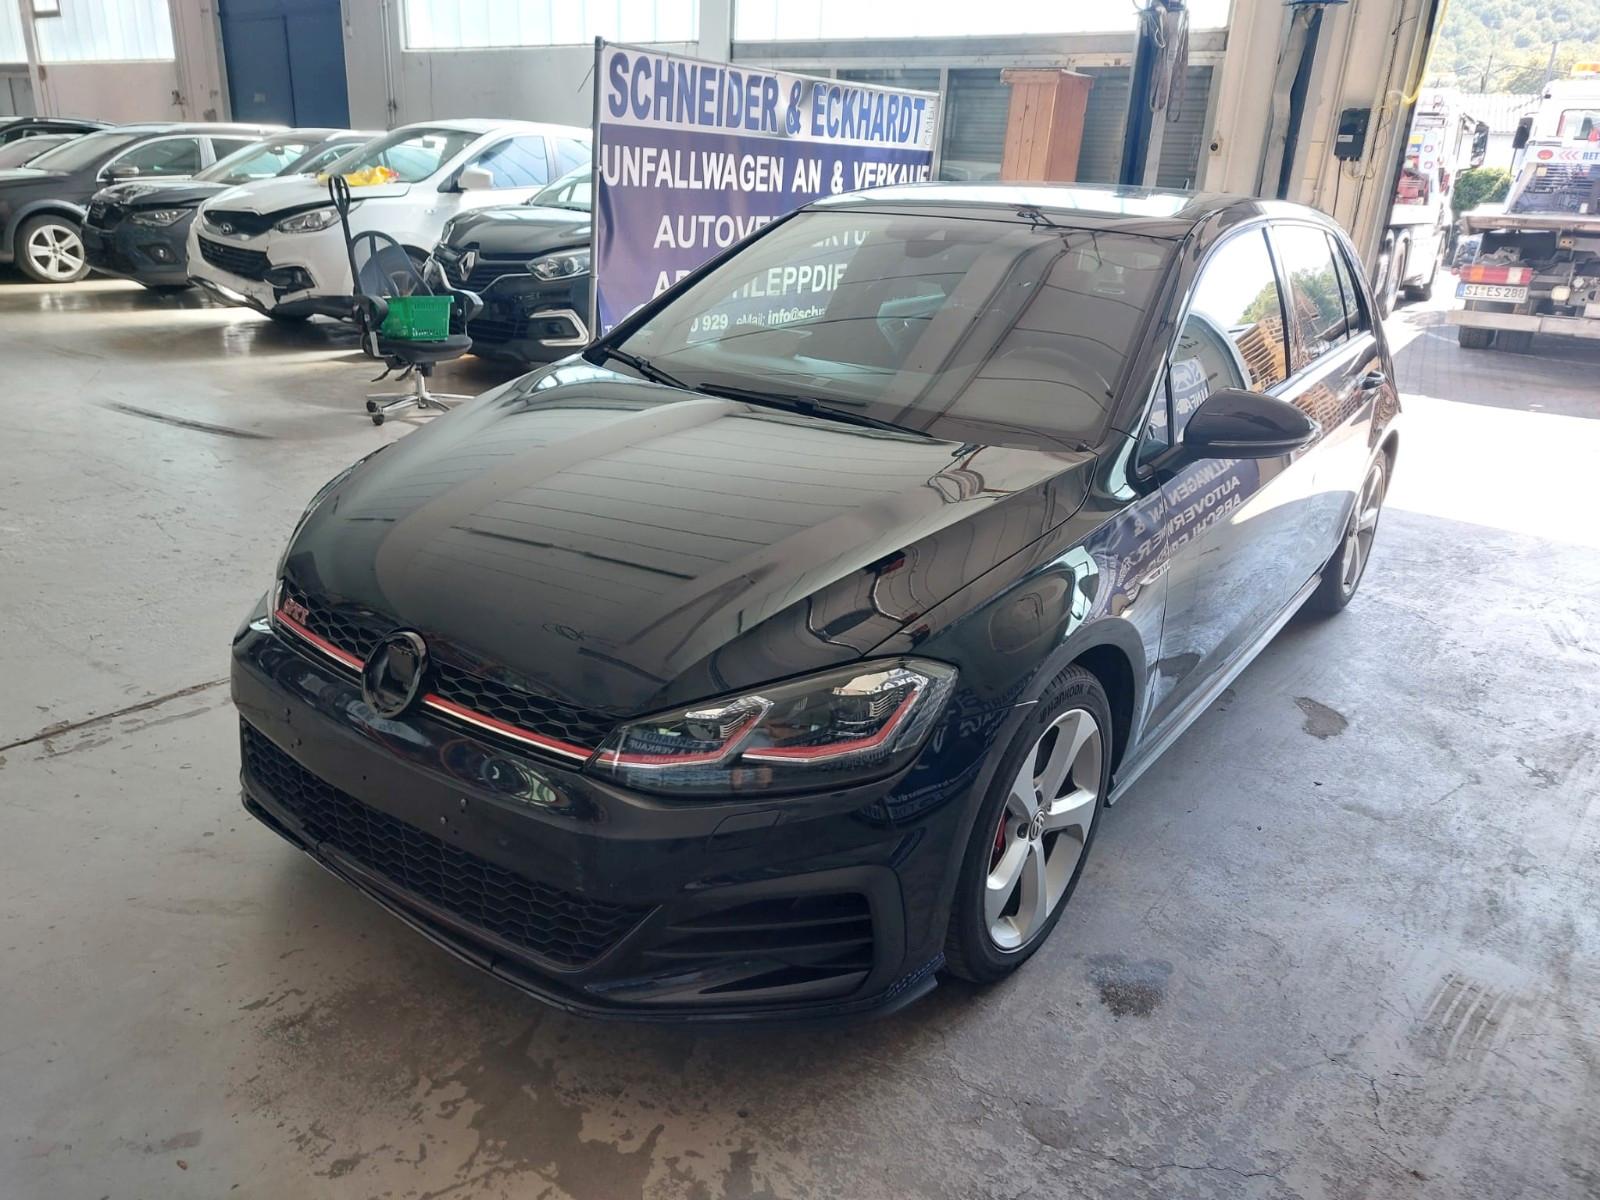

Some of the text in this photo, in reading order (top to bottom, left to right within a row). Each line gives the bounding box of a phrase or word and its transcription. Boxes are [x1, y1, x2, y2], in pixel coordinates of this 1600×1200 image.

[608, 52, 926, 144] SCHNEIDER & ECKHARDT
[602, 144, 784, 192] UNFALLWAGEN
[792, 158, 822, 194] AN
[831, 160, 843, 195] &
[703, 314, 728, 331] 929
